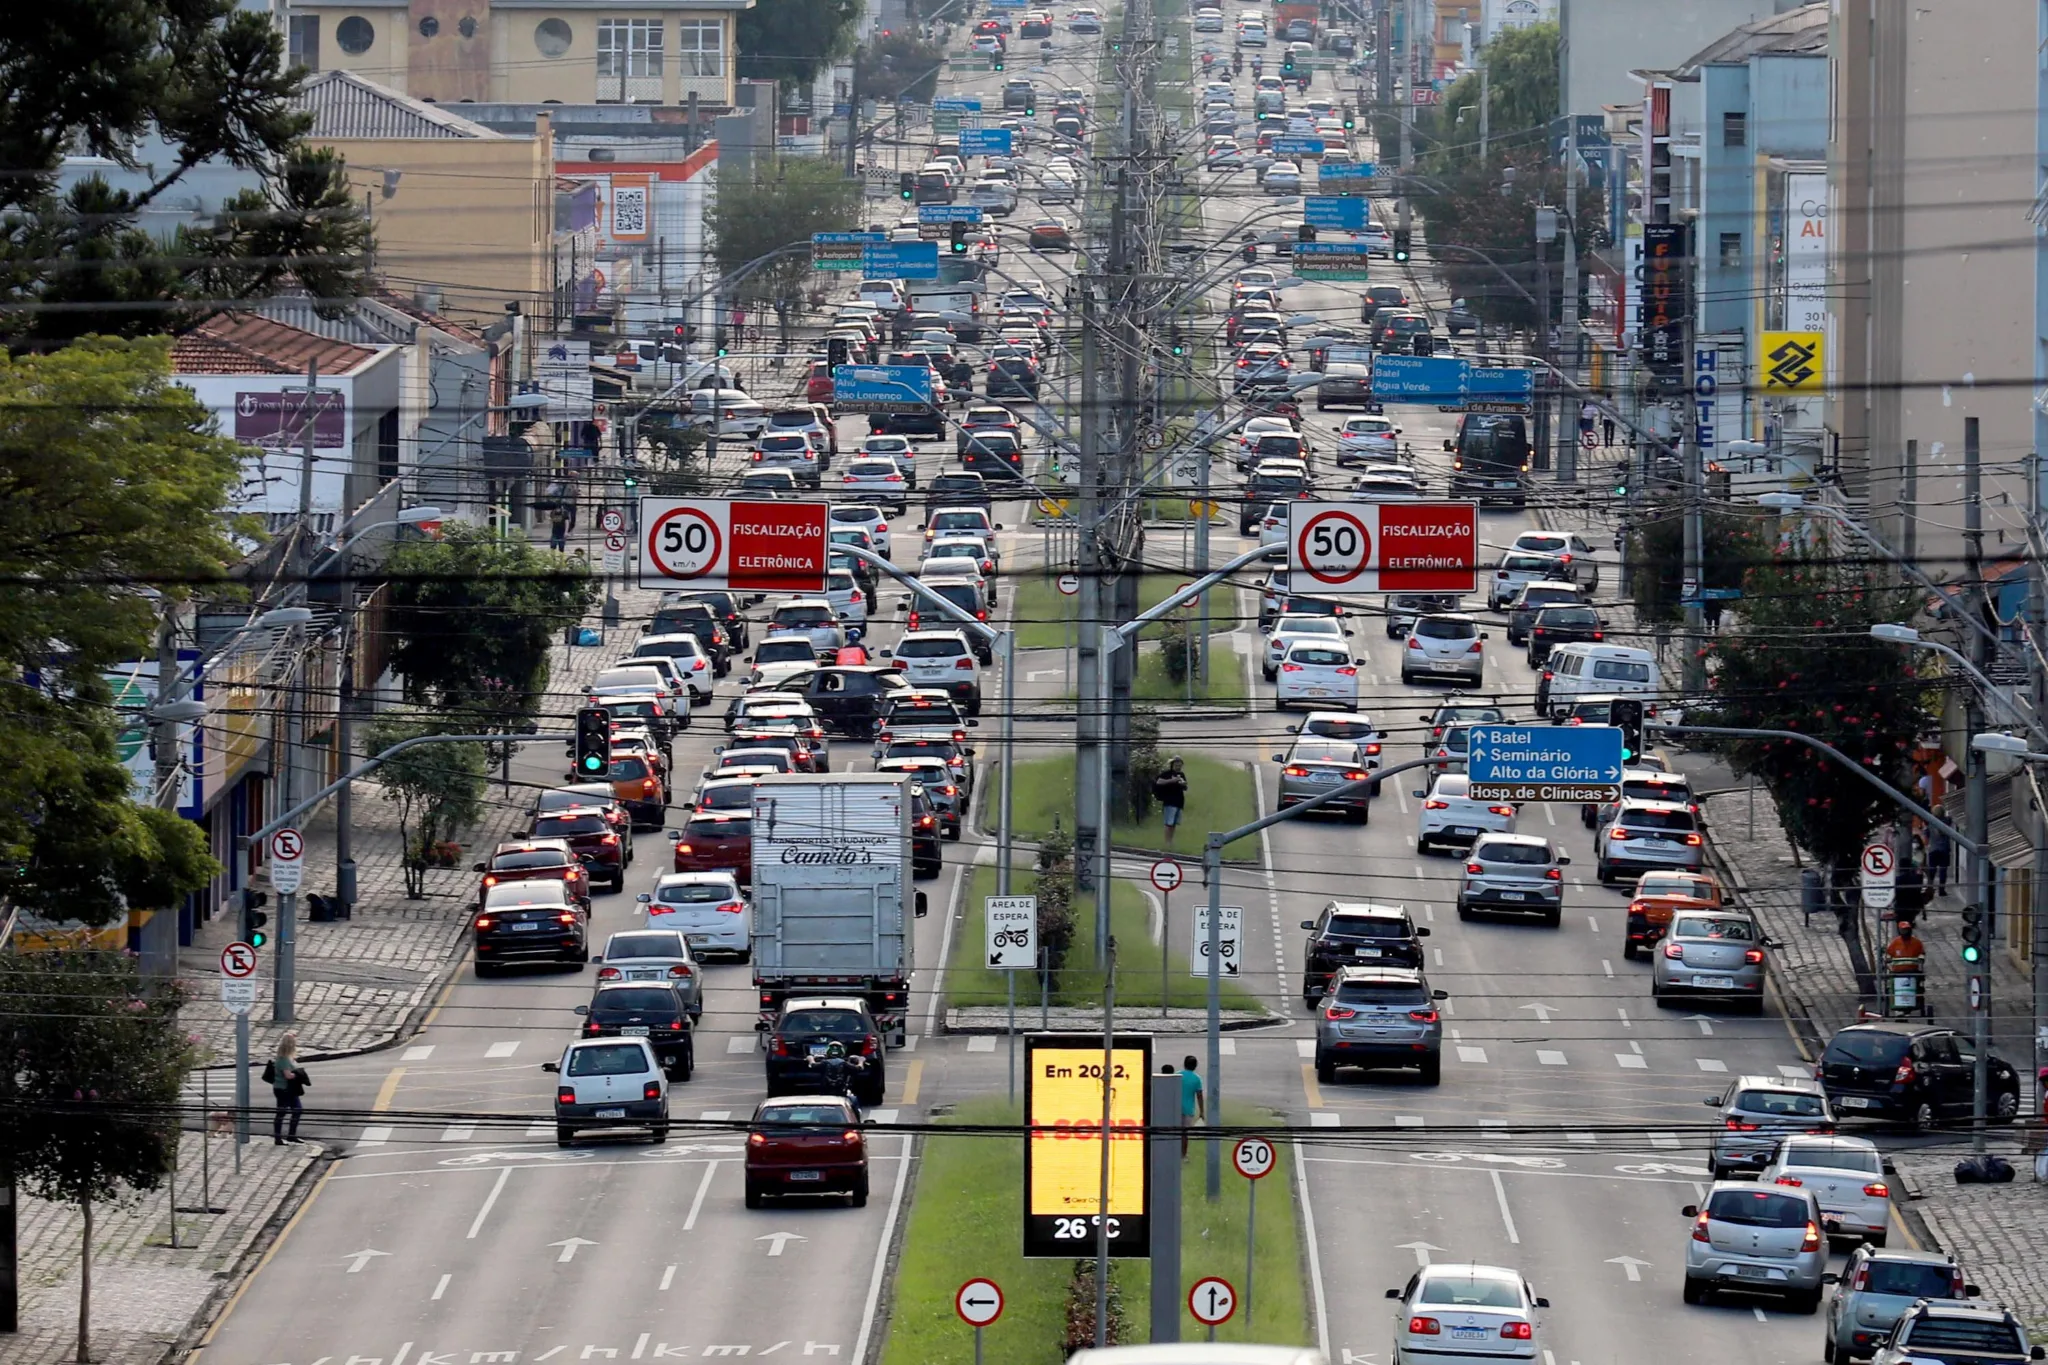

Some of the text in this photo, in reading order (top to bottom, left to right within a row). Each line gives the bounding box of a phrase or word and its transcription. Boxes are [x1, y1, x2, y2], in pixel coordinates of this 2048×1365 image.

[1376, 357, 1422, 368] Rebouças
[1376, 368, 1399, 378] Batel
[1402, 382, 1430, 391] Verde
[836, 390, 902, 401] São Lourenço
[1485, 404, 1516, 412] Arame
[605, 516, 619, 526] 50
[664, 522, 707, 553] 50
[733, 523, 821, 539] FISCALIZAÇÃO
[1382, 523, 1471, 538] FISCALIZAÇÃO
[1313, 526, 1356, 557] 50
[739, 554, 813, 569] ELETRÔNICA
[1389, 554, 1463, 569] ELETRÔNICA
[1491, 731, 1531, 744] Batel
[1491, 748, 1571, 762] Seminário
[1490, 766, 1598, 779] Alto da Glória
[1540, 786, 1602, 800] Clínicas
[781, 845, 873, 864] Camilo's
[991, 900, 1017, 908] ÁREA
[1045, 1065, 1130, 1080] Em 202,
[1241, 1145, 1268, 1164] 50
[1054, 1218, 1087, 1238] 26
